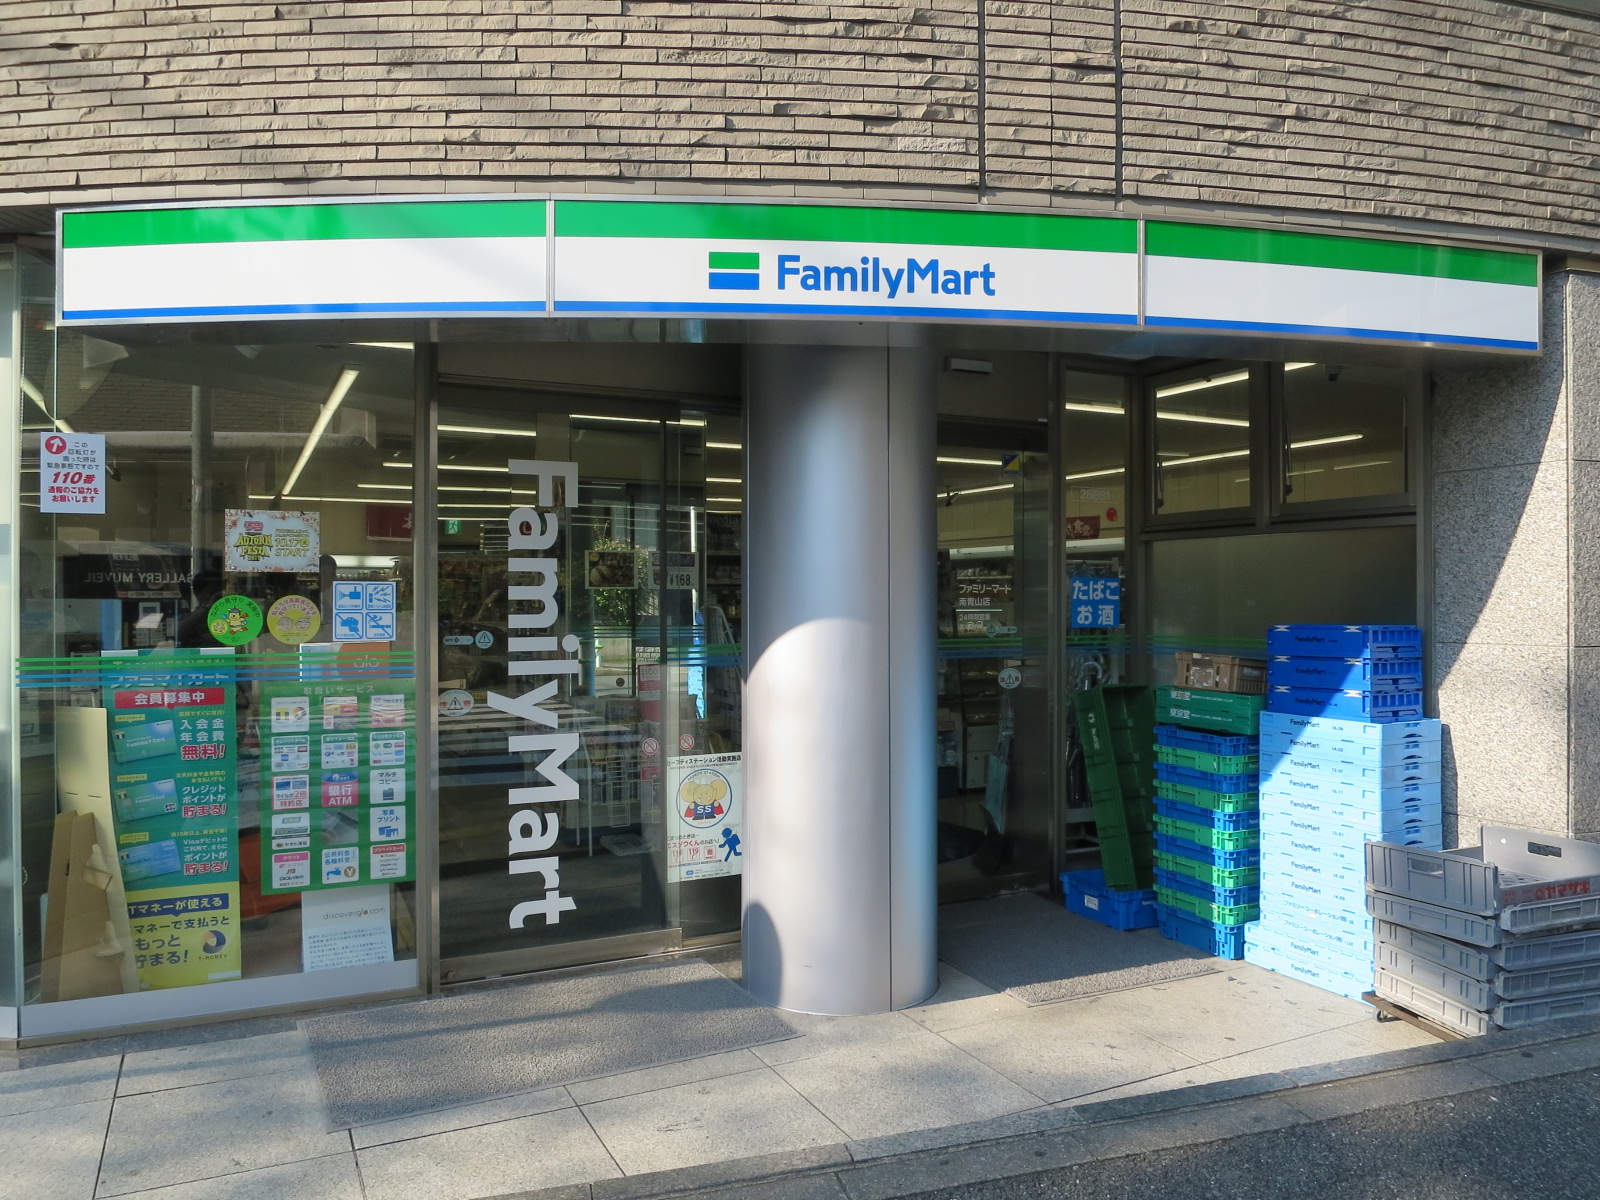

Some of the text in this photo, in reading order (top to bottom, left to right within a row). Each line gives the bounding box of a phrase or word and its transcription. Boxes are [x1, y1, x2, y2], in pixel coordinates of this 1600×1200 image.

[777, 254, 996, 299] FamilyMart
[47, 462, 100, 470] 緊急事態ですので
[52, 471, 96, 484] 110番
[48, 486, 99, 494] 通報のご協力を
[52, 495, 96, 503] お願いします
[240, 546, 270, 557] FESTA
[275, 548, 309, 557] START
[669, 574, 691, 586] ¥168
[958, 584, 1012, 594] ファミリーマート
[1072, 580, 1120, 601] たばこ
[958, 597, 991, 606] 南青山店
[958, 613, 991, 621] 24時間営業
[1076, 605, 1115, 626] お酒
[1295, 635, 1325, 643] FamilyMart
[1295, 667, 1326, 675] FamilyMart
[303, 685, 374, 695] 取扱いサービス
[487, 459, 580, 930] FamilyMart
[135, 691, 205, 705] 会員募集中
[1295, 697, 1325, 706] FamilyMart
[180, 718, 225, 730] 入会金
[1290, 718, 1320, 728] FamilyMart
[180, 731, 225, 742] 年会費
[1290, 739, 1320, 749] FamilyMart
[181, 743, 226, 760] 無料!
[1290, 759, 1320, 770] FamilyMart
[687, 771, 721, 781] SAFETY STATION
[182, 784, 225, 795] クレジット
[1289, 779, 1319, 790] FamilyMart
[328, 785, 352, 796] 銀行
[182, 794, 226, 804] ポイントが
[328, 797, 352, 805] ATM
[182, 803, 227, 819] 貯まる!
[696, 805, 712, 814] SS
[1290, 800, 1320, 811] FamilyMart
[377, 815, 400, 823] プリント
[1290, 820, 1320, 832] FamilyMart
[1291, 840, 1321, 852] FamilyMart
[184, 851, 228, 861] ポイントが
[324, 850, 350, 858] 公共料金
[324, 857, 350, 865] 各種料金
[184, 861, 228, 876] 貯まる!
[1291, 861, 1321, 874] FamilyMart
[1291, 881, 1321, 895] FamilyMart
[1545, 881, 1591, 898] ヤマザキ
[129, 897, 223, 914] Tマネーが使える
[131, 916, 230, 933] マネーで支払うと
[135, 935, 181, 951] もっと
[1290, 942, 1319, 956] FamilyMart
[1290, 963, 1320, 978] FamilyMart
